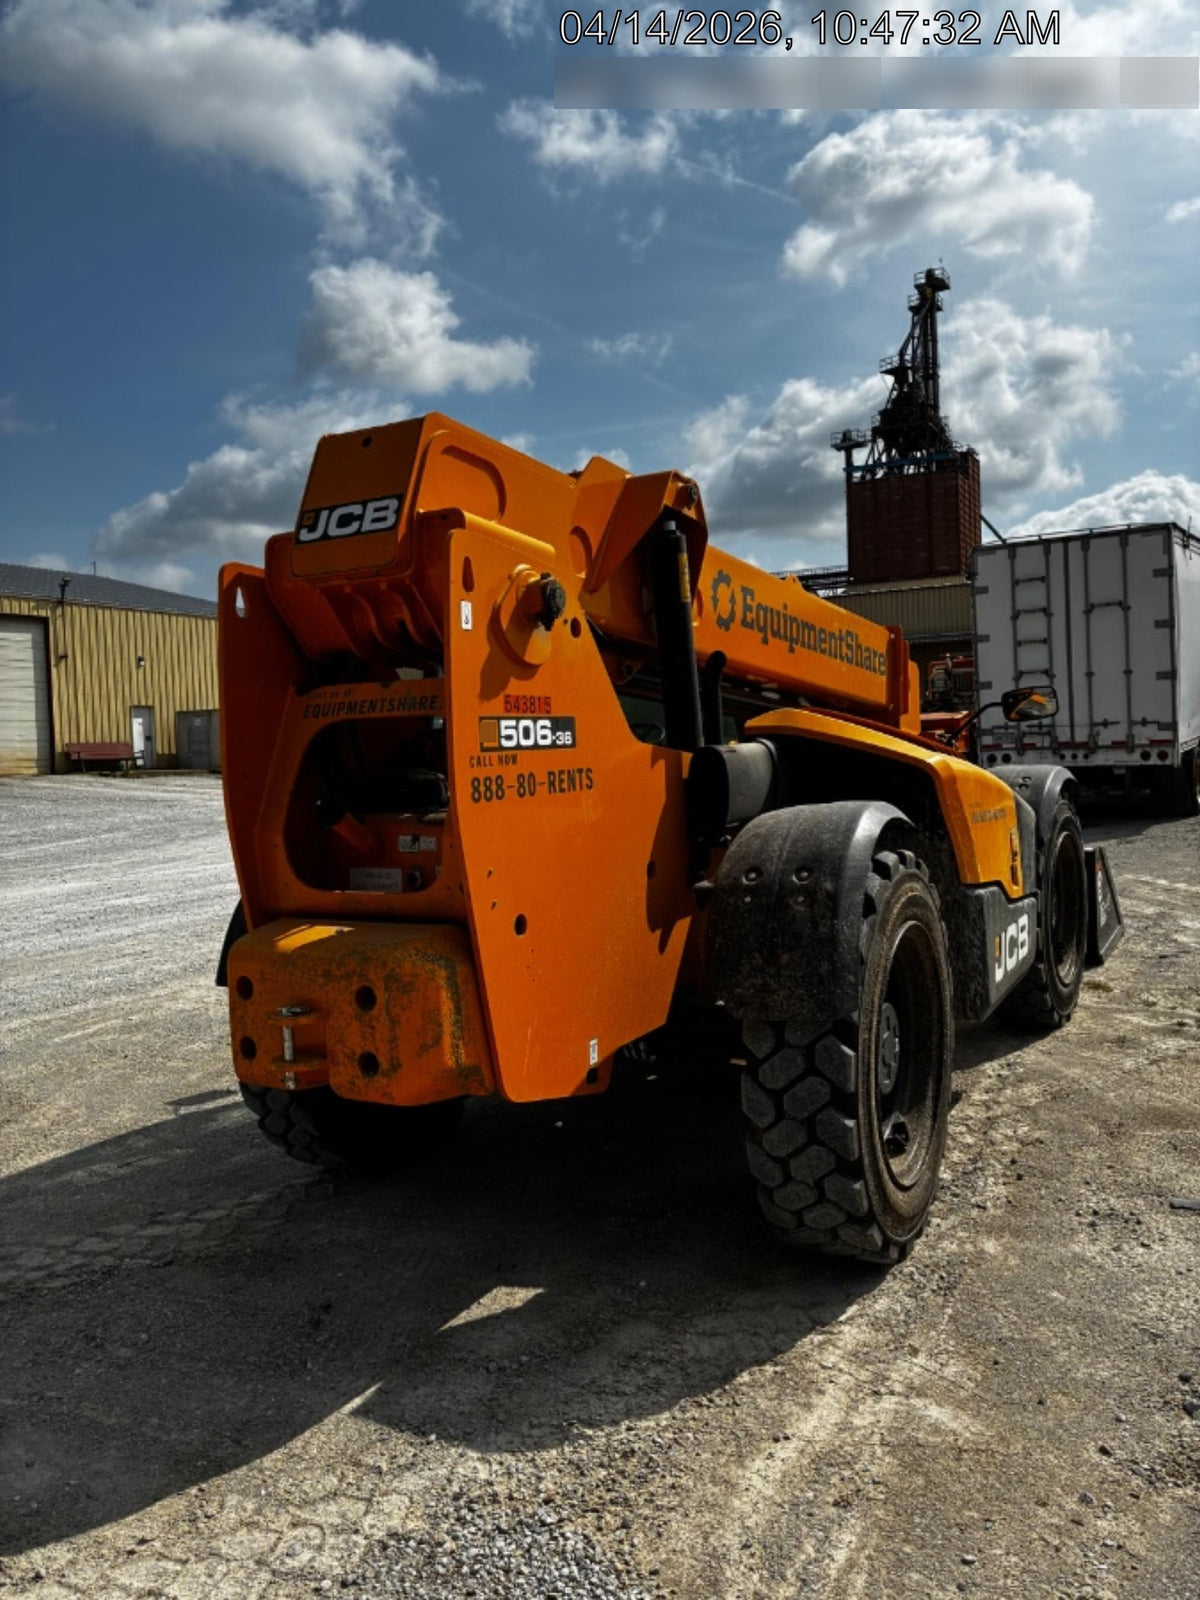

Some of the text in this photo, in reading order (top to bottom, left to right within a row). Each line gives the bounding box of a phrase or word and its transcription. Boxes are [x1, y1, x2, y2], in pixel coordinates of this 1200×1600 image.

[298, 498, 399, 542] JCB
[741, 585, 887, 676] EquipmentShare
[504, 694, 552, 713] 543815
[469, 754, 517, 768] CALL NOW
[471, 767, 594, 803] 888-80-RENTS
[995, 913, 1029, 982] JCB
